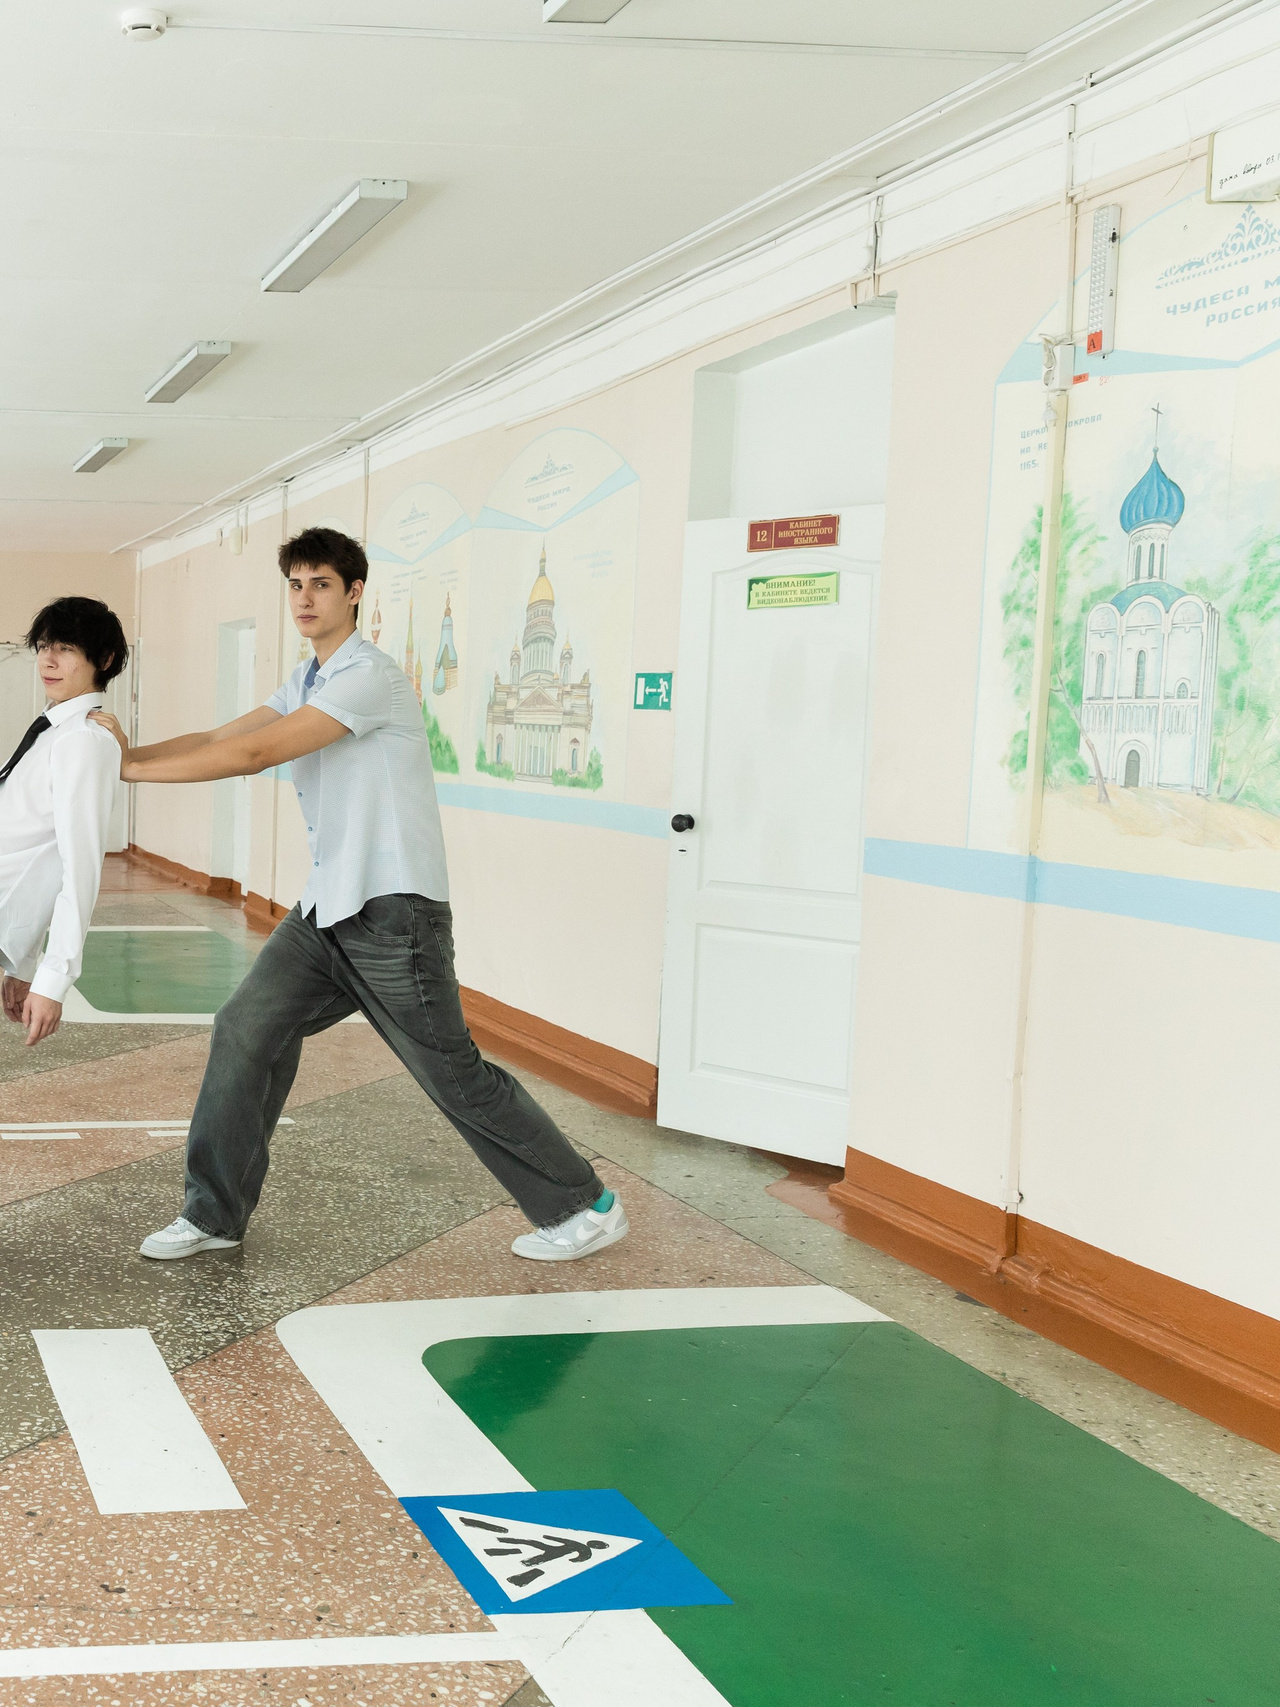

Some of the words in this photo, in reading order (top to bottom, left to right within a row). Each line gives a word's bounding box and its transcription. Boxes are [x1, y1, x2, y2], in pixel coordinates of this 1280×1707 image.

[1166, 285, 1249, 316] ЧУДЕСА
[1067, 414, 1102, 428] ОКРОВА
[789, 520, 822, 529] КАБИНЕТ
[756, 530, 768, 542] 12
[778, 527, 833, 538] ИНОСТРАННОГО
[794, 536, 818, 545] ЯЗЫКА
[765, 579, 816, 589] ВНИМАНИЕ!
[762, 589, 798, 597] КАБИНЕТЕ
[800, 587, 831, 595] ВЕДЕТСЯ
[757, 595, 829, 605] ВИДЕОНАБЛЮДЕНИЕ
